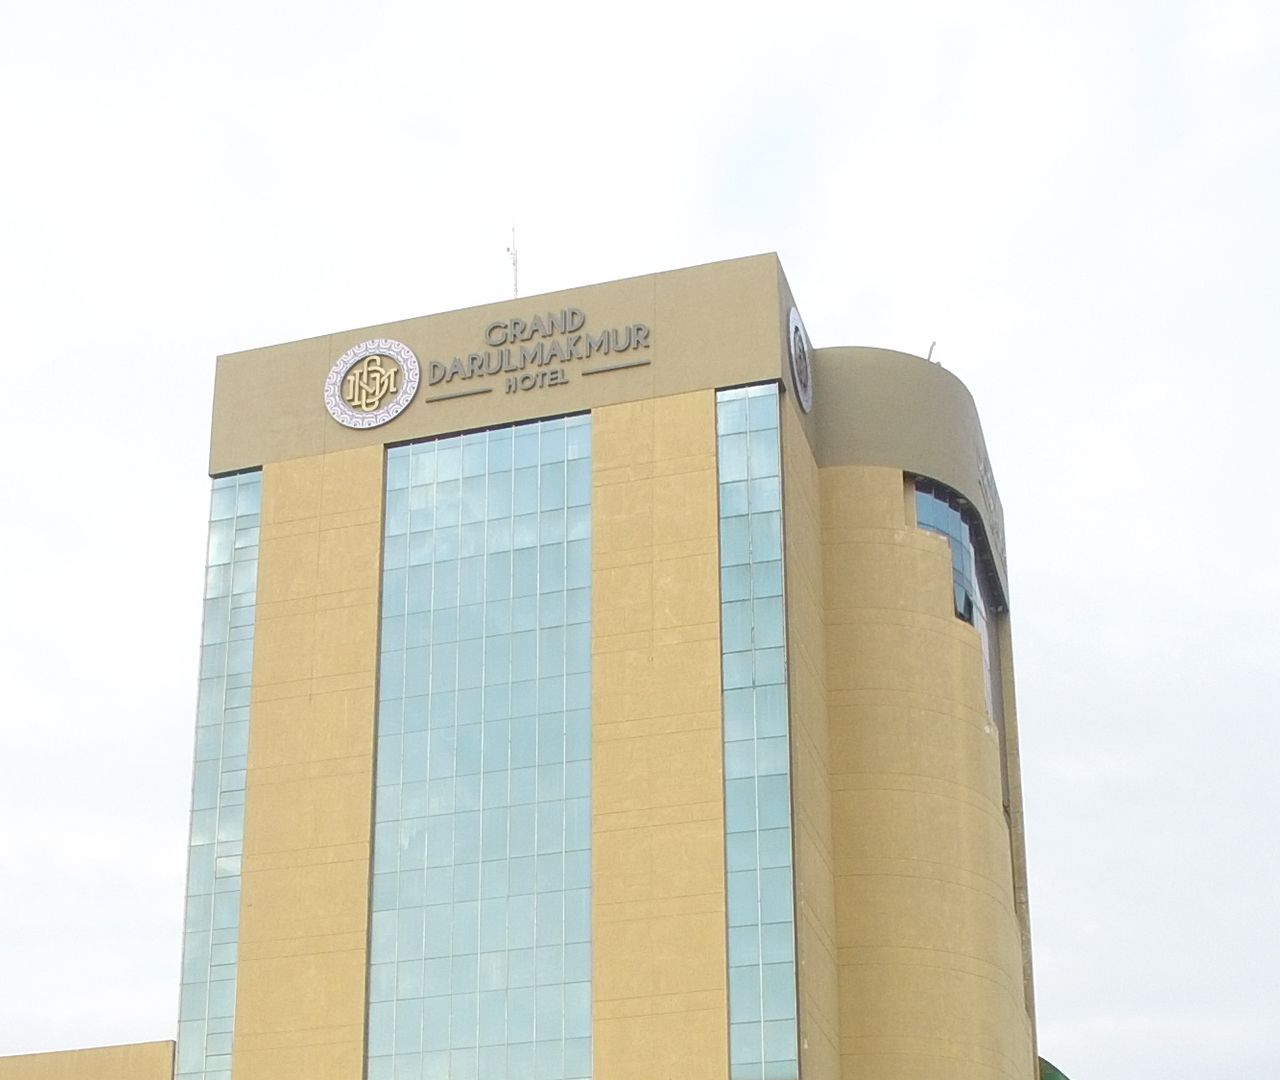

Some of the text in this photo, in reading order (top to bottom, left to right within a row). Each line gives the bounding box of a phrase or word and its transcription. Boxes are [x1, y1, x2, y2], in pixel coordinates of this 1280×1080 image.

[485, 308, 586, 347] GRAND
[428, 323, 650, 386] DARULMAKMUR
[505, 368, 569, 393] HOTEL
